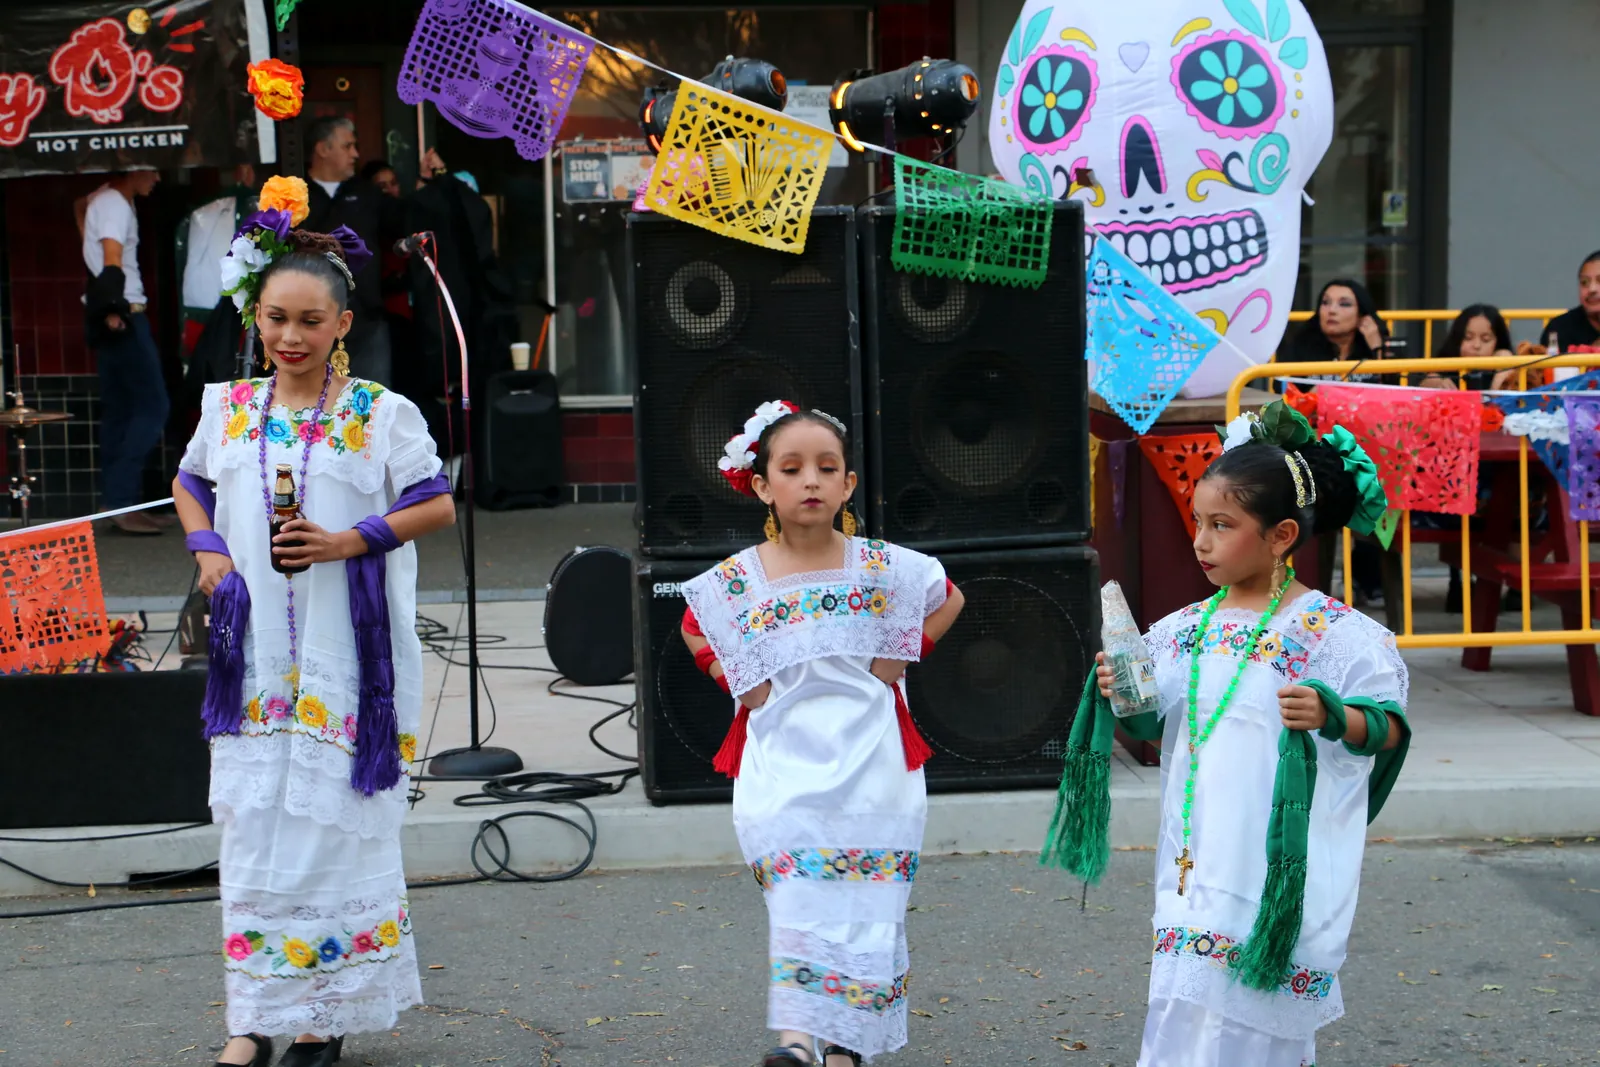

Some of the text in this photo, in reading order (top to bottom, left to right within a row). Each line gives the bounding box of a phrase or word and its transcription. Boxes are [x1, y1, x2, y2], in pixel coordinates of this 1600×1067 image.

[37, 133, 184, 153] HOT CHICKEN
[570, 159, 601, 170] STOP
[653, 582, 681, 594] GEN
